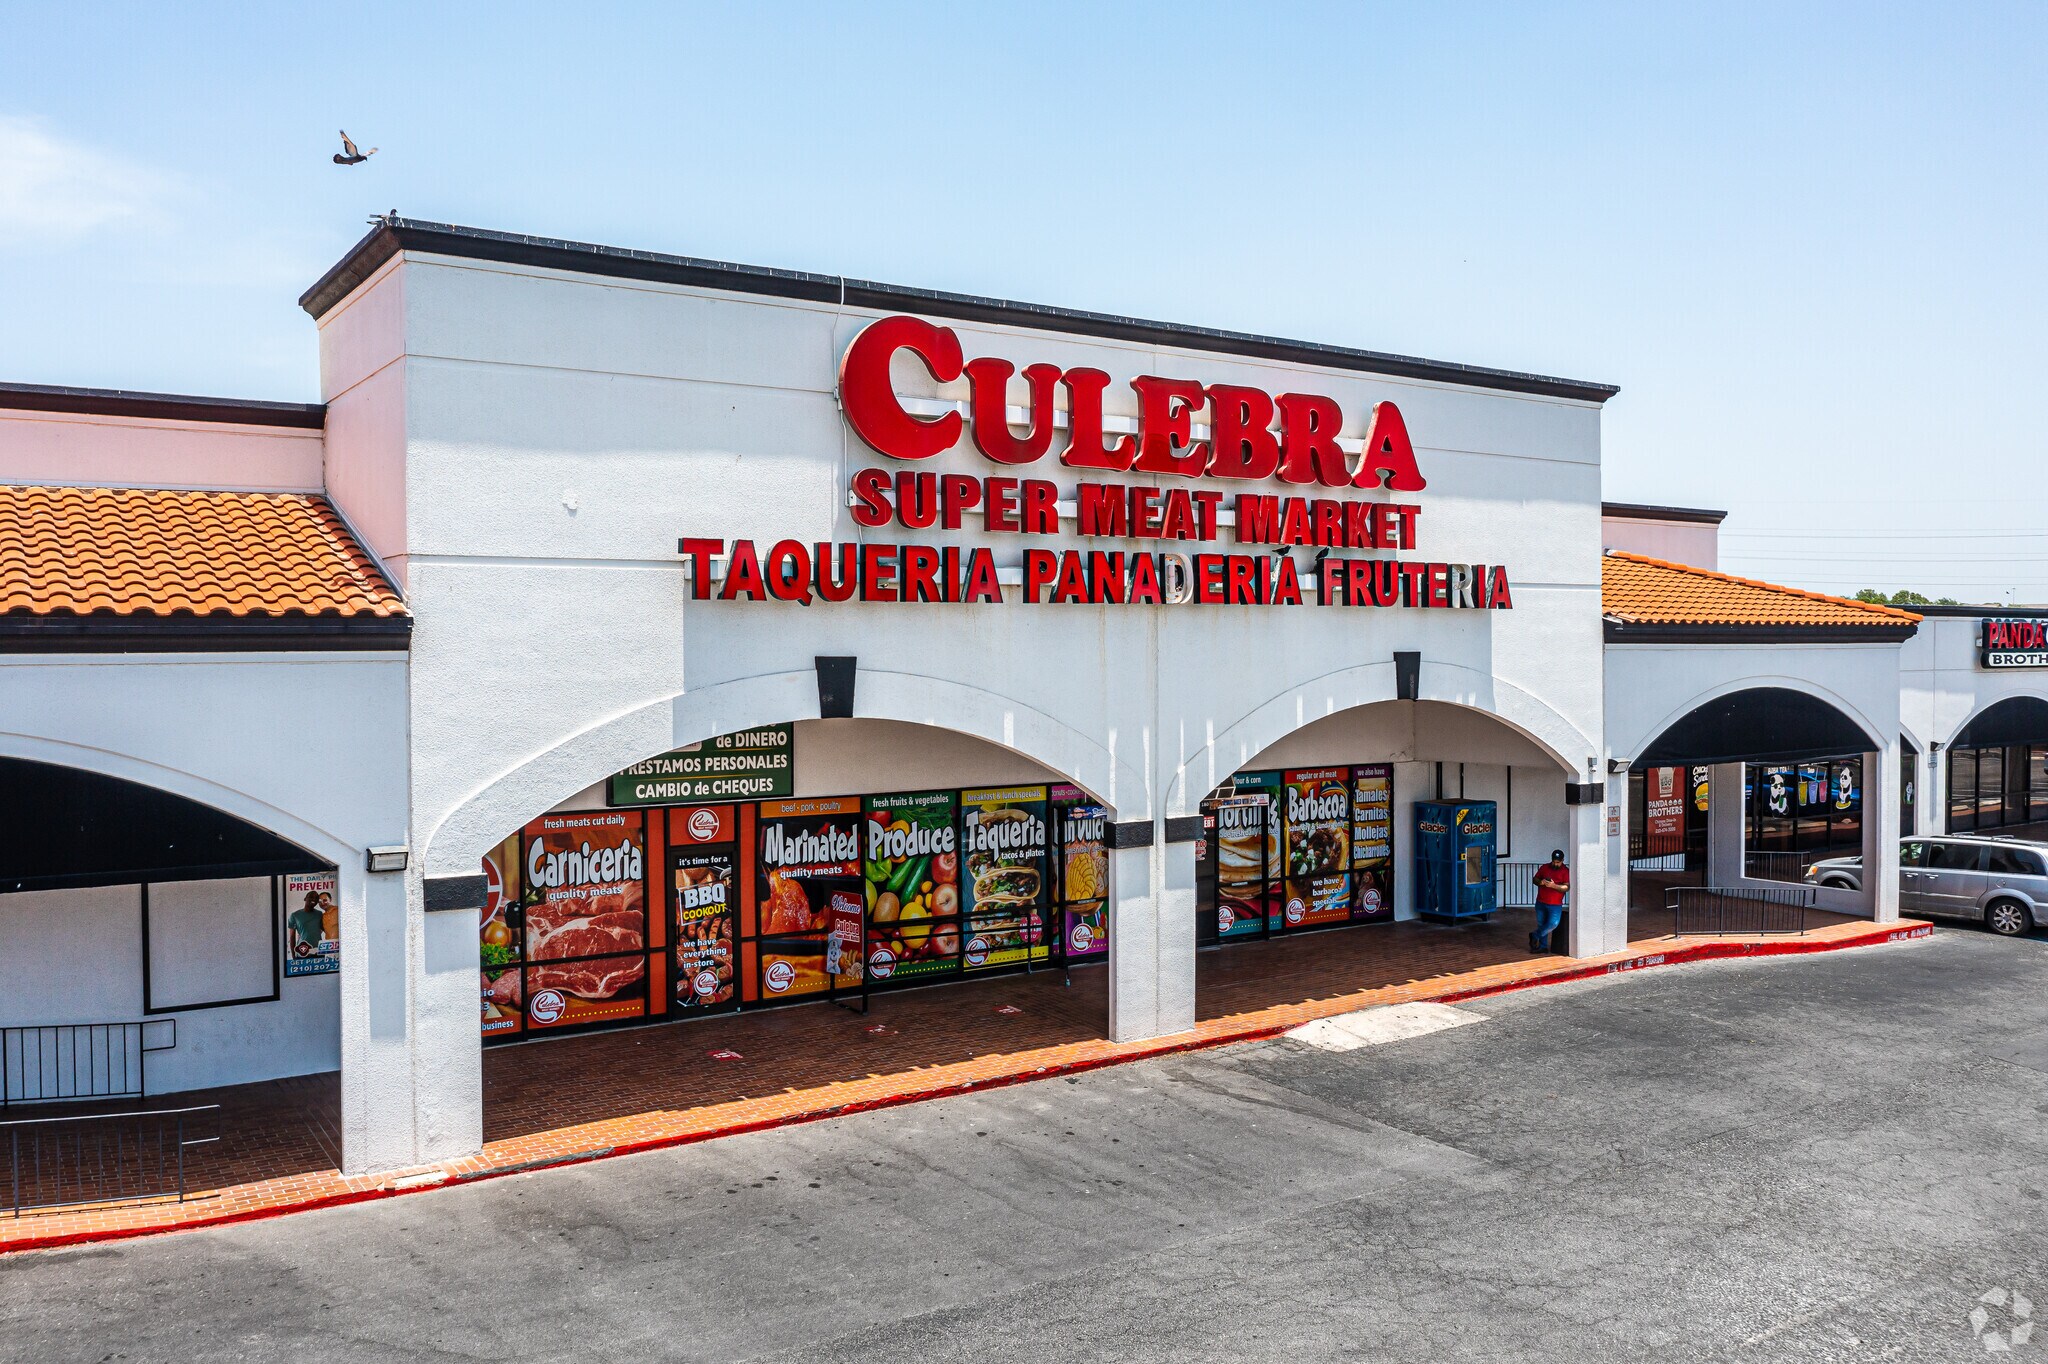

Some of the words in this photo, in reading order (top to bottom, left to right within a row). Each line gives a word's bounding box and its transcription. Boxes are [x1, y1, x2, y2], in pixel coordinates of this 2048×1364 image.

[838, 315, 1427, 491] CULEBRA
[850, 468, 1060, 535] SUPER
[1077, 483, 1223, 541] MEAT
[1235, 493, 1422, 550] MARKET
[678, 537, 1004, 606] TAQUERIA
[1023, 548, 1303, 606] PANADERIA
[1317, 557, 1513, 609] FRUTERIA
[1985, 620, 2045, 649] PANDA
[716, 736, 732, 749] de
[735, 731, 788, 748] DINERO
[705, 754, 788, 772] PERSONALES
[1296, 772, 1313, 781] regular
[1325, 770, 1337, 778] meat
[1364, 768, 1374, 776] also
[1374, 767, 1385, 775] have
[635, 782, 691, 799] CAMBIO
[694, 781, 709, 796] de
[712, 778, 773, 796] CHEQUES
[967, 792, 995, 802] breakfast
[1002, 791, 1018, 800] lunch
[1019, 789, 1041, 799] specials
[873, 798, 889, 808] fresh
[890, 796, 908, 807] fruits
[908, 796, 914, 805] &
[915, 794, 949, 806] vegetables
[1355, 789, 1388, 803] Tamales
[781, 802, 796, 813] beef
[800, 802, 815, 813] pork
[820, 801, 841, 812] poultry
[1288, 786, 1346, 823] Barbacoa
[1648, 799, 1668, 809] PANDA
[1355, 806, 1388, 822] Carnitas
[1648, 806, 1683, 818] BROTHERS
[544, 819, 564, 829] fresh
[566, 818, 591, 828] meats
[592, 816, 605, 825] cut
[606, 814, 626, 826] daily
[1203, 819, 1215, 828] EBT
[1419, 821, 1448, 834] Glacier
[1463, 822, 1492, 834] Glacier
[868, 819, 955, 861] Produce
[966, 811, 1046, 862] Taqueria
[1354, 825, 1388, 841] Mollejas
[765, 823, 858, 867] Marinated
[1353, 844, 1390, 860] Chicharrones
[679, 858, 691, 866] it's
[692, 857, 709, 865] time
[711, 856, 721, 864] for
[1001, 852, 1018, 860] tacos
[1019, 849, 1024, 859] &
[1025, 848, 1045, 859] plates
[528, 836, 642, 888] Carniceria
[780, 868, 812, 880] quality
[814, 866, 843, 876] meats
[290, 881, 335, 892] PREVENT
[1312, 879, 1323, 887] we
[1323, 877, 1339, 886] have
[549, 888, 587, 901] quality
[590, 886, 623, 896] meats
[684, 883, 726, 909] BBQ
[1312, 887, 1342, 897] barbacoa
[831, 894, 861, 914] Welcome
[1312, 897, 1337, 908] specials
[683, 903, 727, 921] COOKOUT
[697, 938, 717, 946] have
[683, 947, 727, 959] everything
[290, 965, 312, 974] (210)
[683, 959, 714, 969] in-store
[481, 1020, 514, 1031] business
